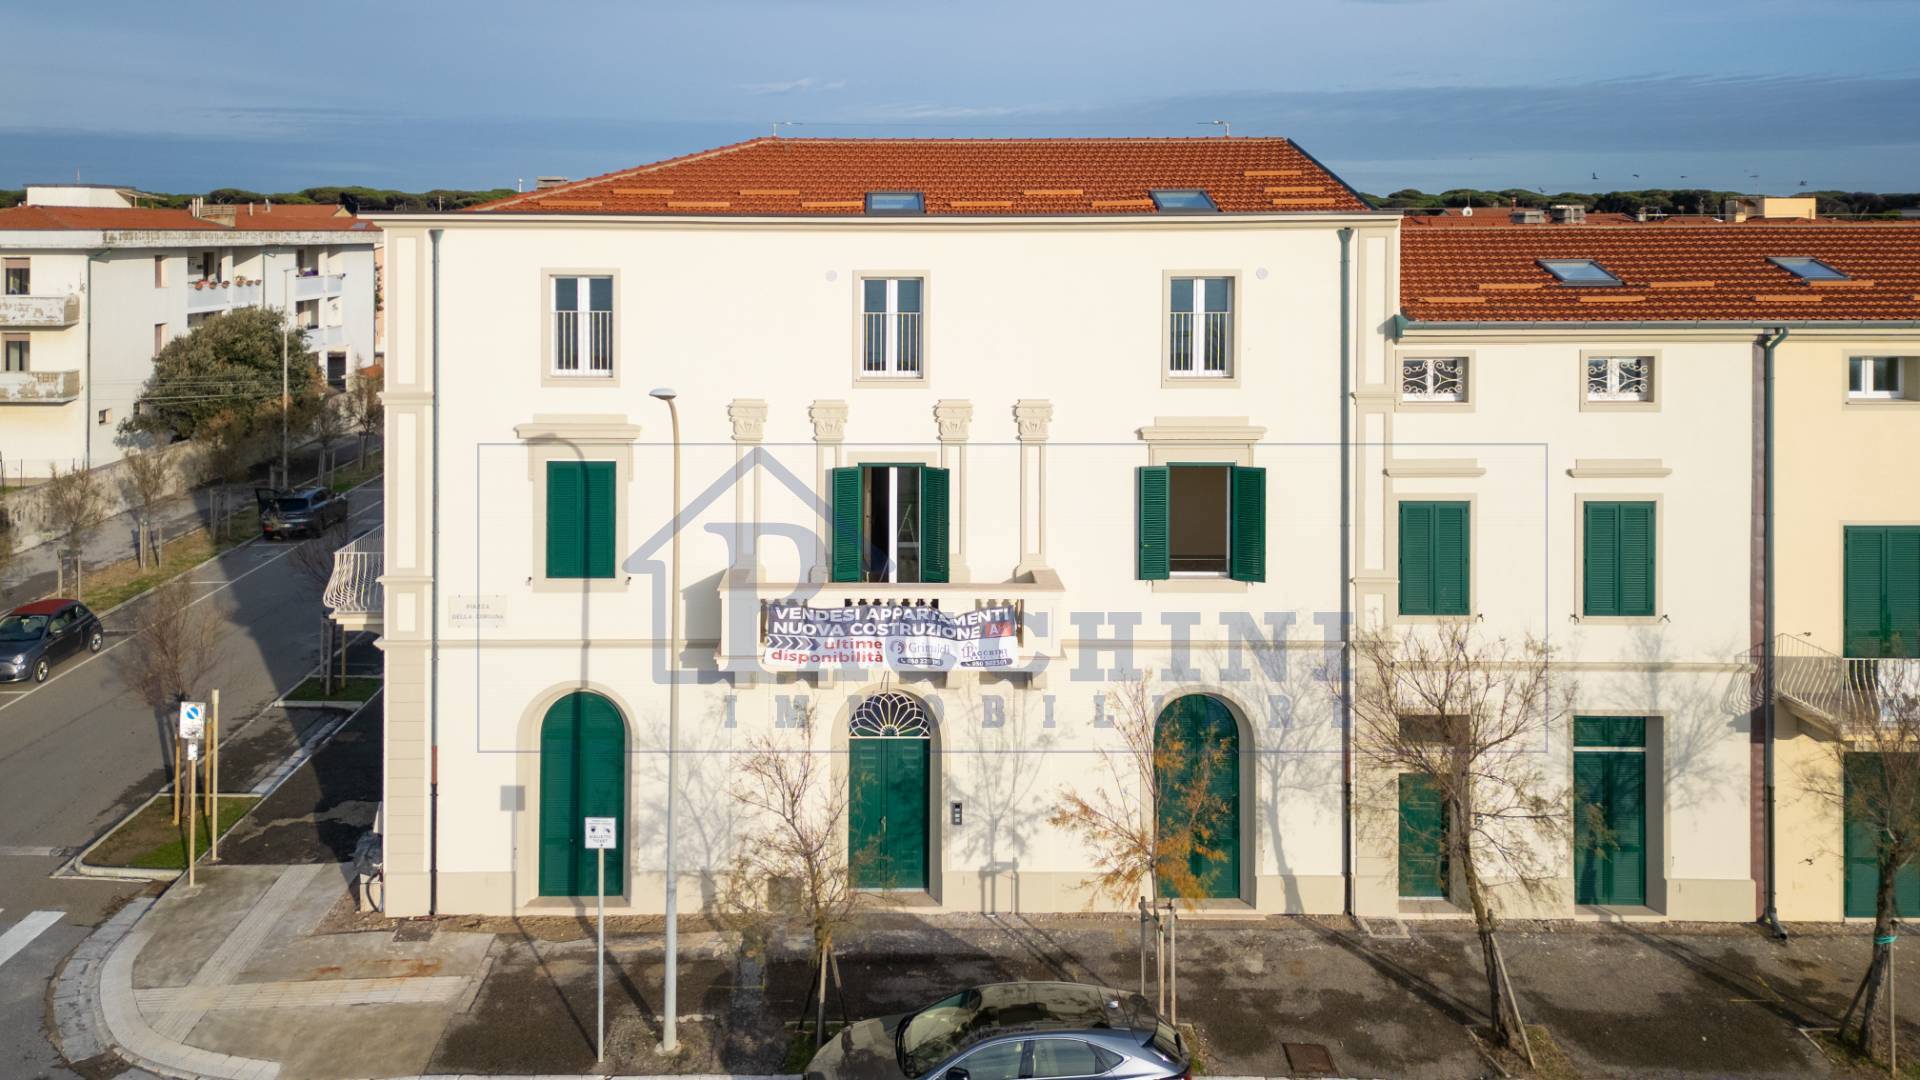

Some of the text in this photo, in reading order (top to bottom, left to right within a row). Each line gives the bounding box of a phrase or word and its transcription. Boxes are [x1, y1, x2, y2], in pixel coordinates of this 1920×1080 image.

[776, 607, 860, 622] VENDESI
[773, 621, 845, 636] NUOVA
[850, 622, 981, 640] COSTRUZIONE
[824, 639, 883, 650] ultime
[771, 650, 883, 663] disponibilità
